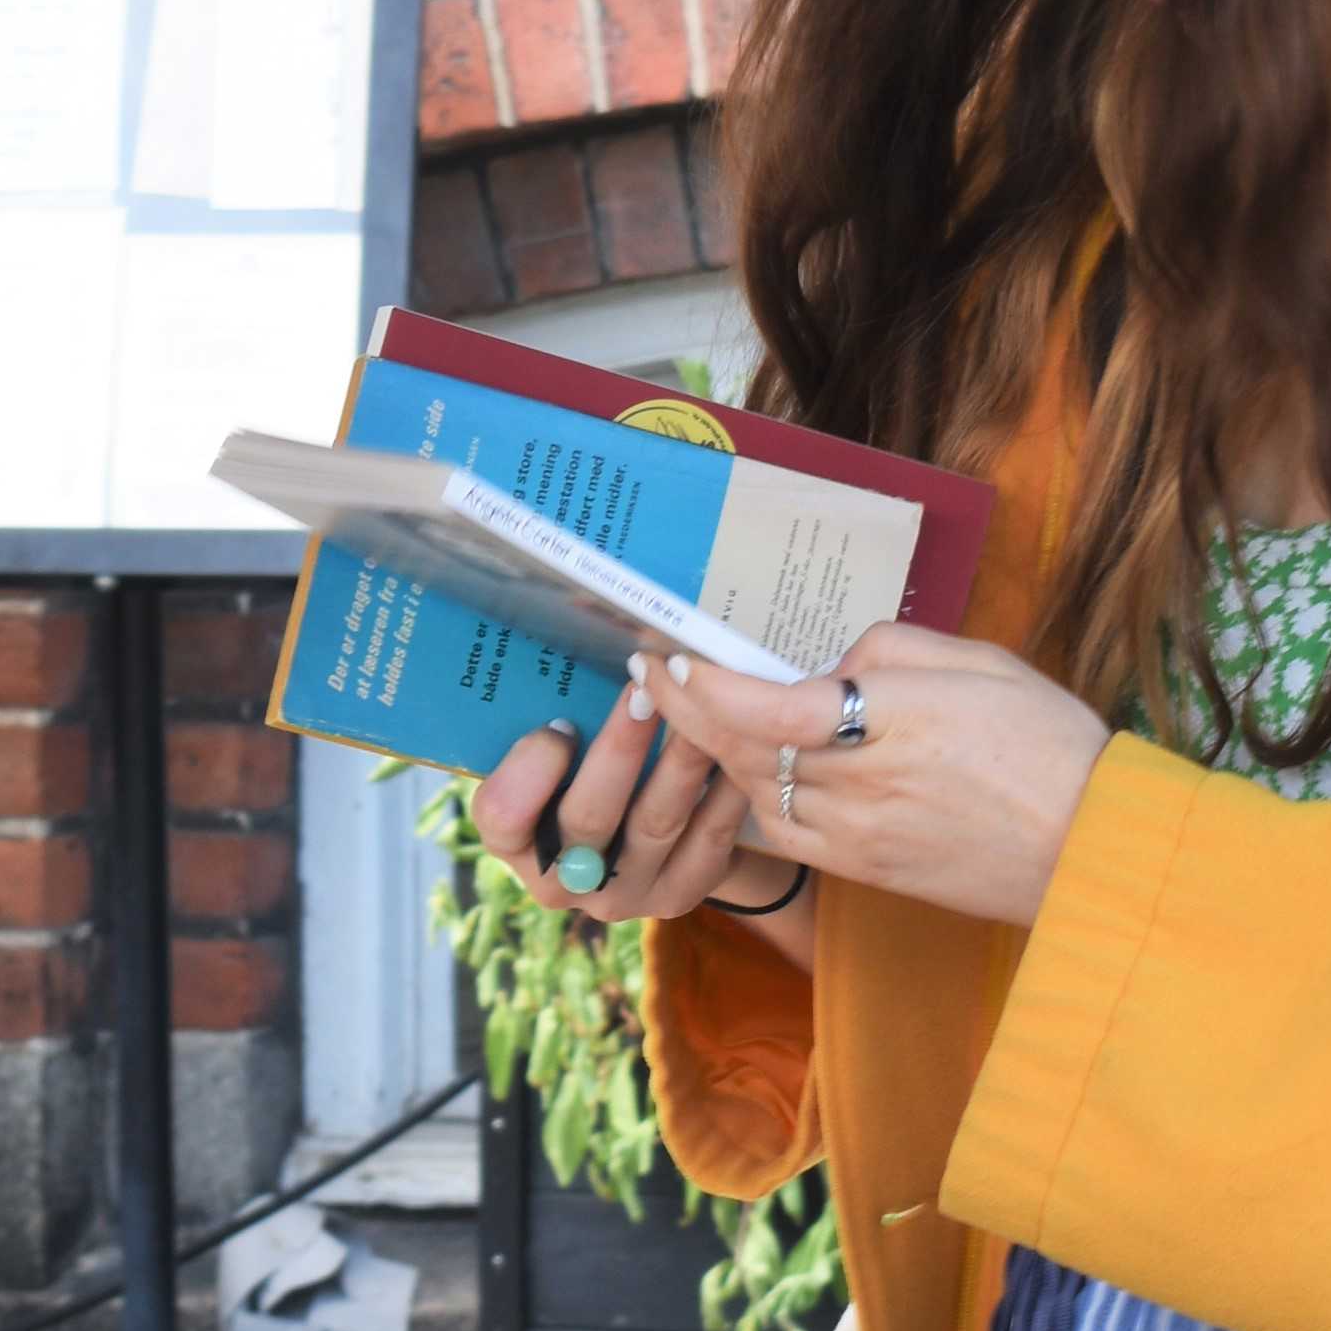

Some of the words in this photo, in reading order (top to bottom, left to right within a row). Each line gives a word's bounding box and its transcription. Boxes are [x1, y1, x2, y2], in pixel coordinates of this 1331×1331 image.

[536, 442, 563, 505] mening
[588, 455, 606, 482] med
[344, 571, 375, 632] draget
[341, 636, 357, 656] er
[359, 610, 392, 675] læseren
[377, 646, 408, 708] holdes
[393, 605, 419, 642] fast
[460, 638, 486, 690] Dette
[326, 664, 351, 694] Der
[355, 678, 371, 701] at
[479, 659, 506, 704] både
